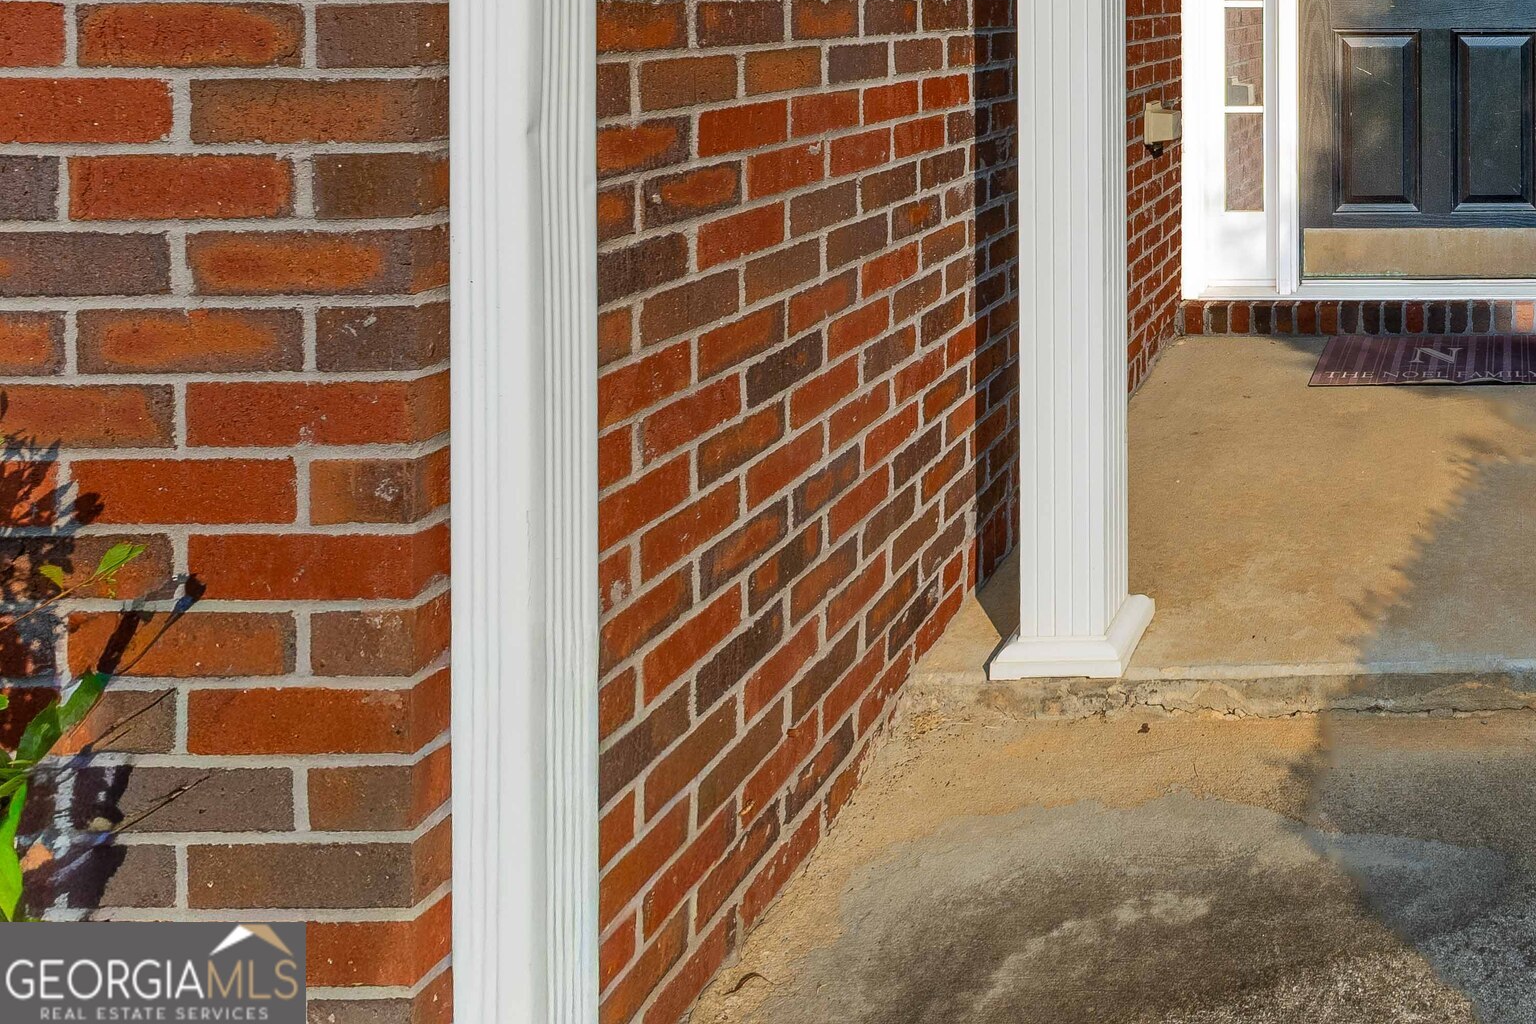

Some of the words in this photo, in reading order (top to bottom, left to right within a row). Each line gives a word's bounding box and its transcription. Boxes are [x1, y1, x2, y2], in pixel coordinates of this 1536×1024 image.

[1409, 347, 1463, 364] N
[1325, 370, 1375, 379] THE
[1382, 370, 1450, 379] NOEL
